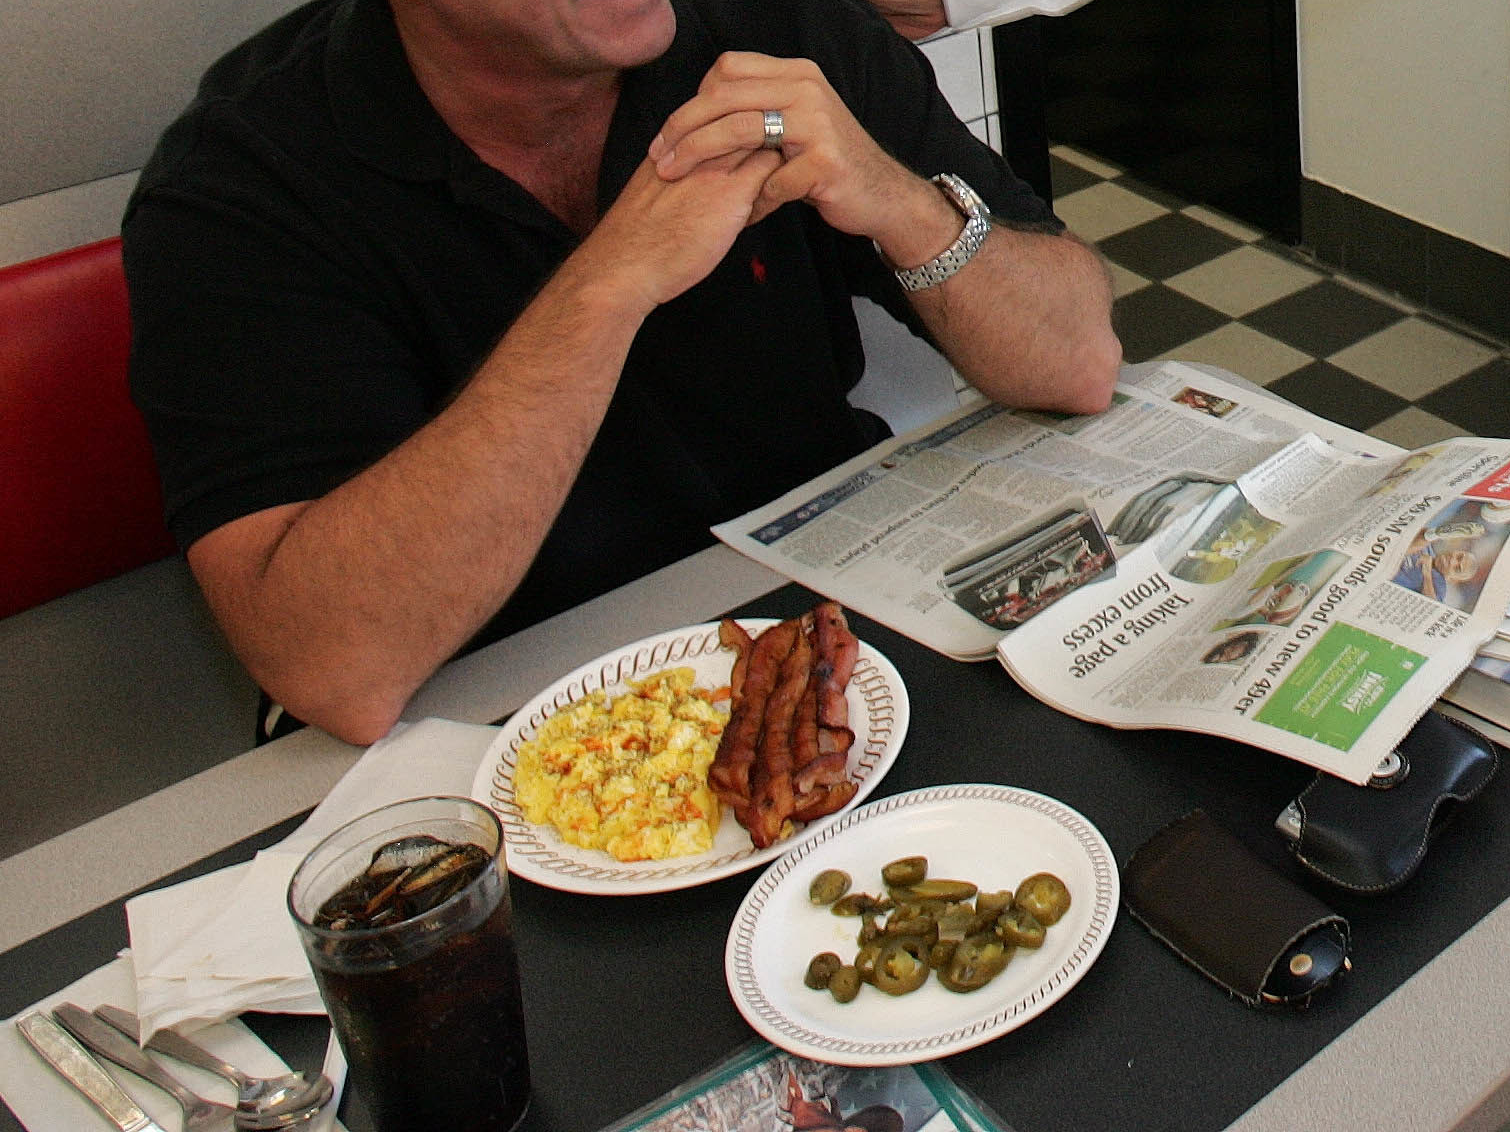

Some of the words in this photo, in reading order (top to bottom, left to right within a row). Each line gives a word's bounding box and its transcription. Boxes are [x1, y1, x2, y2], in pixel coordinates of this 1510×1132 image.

[1343, 533, 1392, 587] sounds
[1118, 572, 1170, 610] from
[1311, 583, 1350, 624] good
[1062, 604, 1122, 651] excess
[1123, 592, 1195, 637] Taking
[1295, 622, 1319, 639] to
[1068, 639, 1118, 678] page
[1112, 633, 1131, 645] a
[1265, 640, 1301, 677] new
[1234, 677, 1272, 716] 49er
